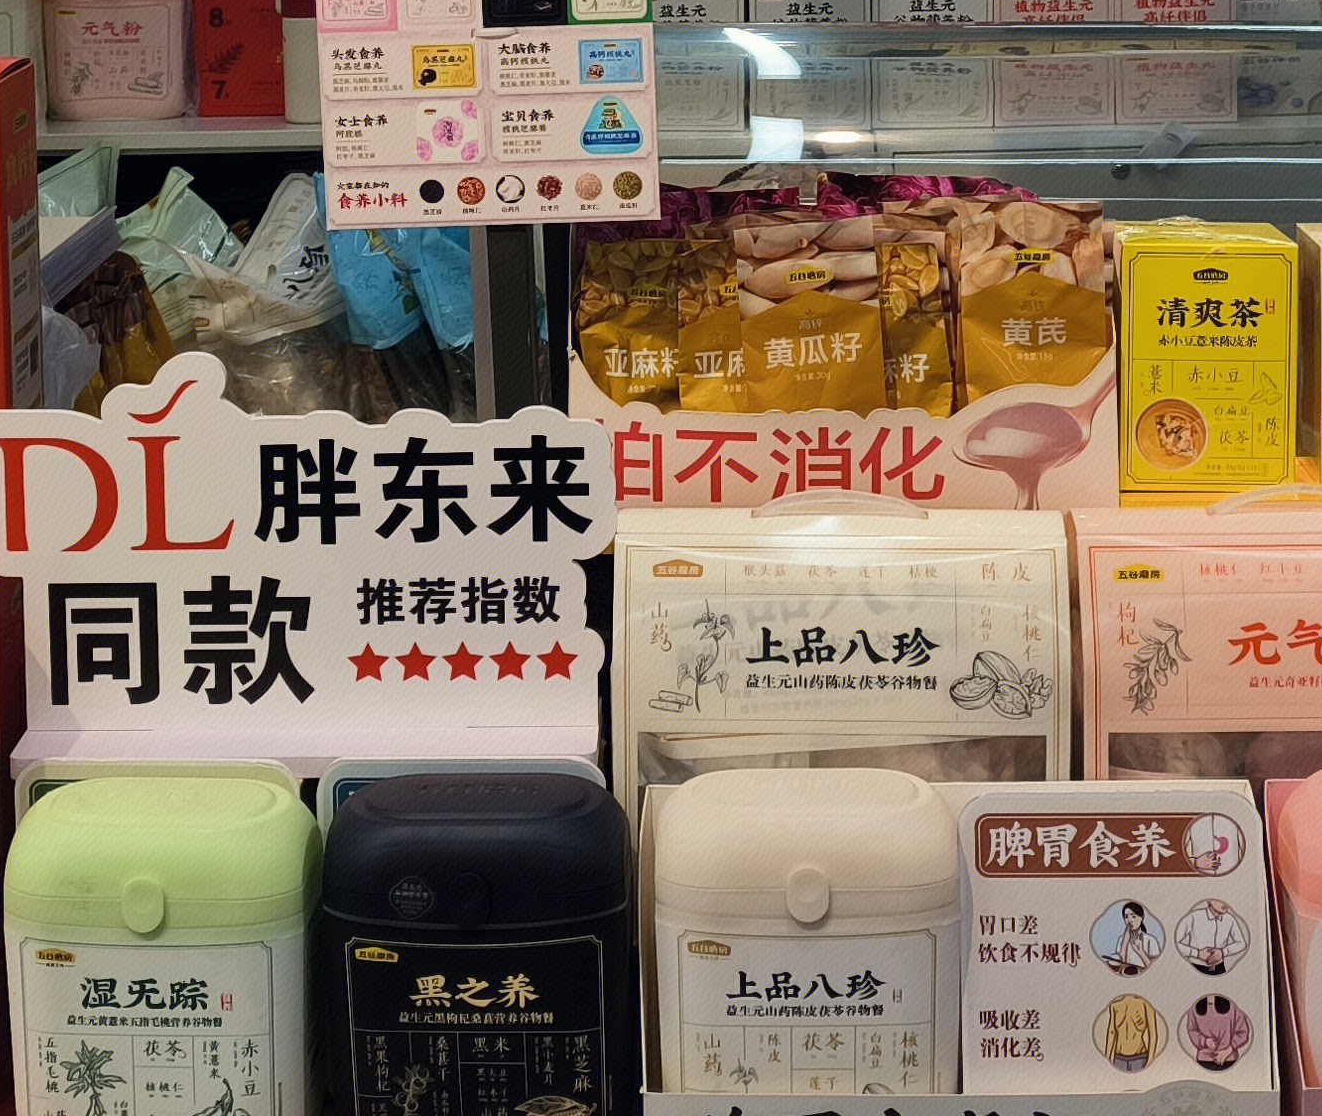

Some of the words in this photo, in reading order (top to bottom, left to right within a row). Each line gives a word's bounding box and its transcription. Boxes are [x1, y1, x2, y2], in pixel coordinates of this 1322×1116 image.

[81, 20, 143, 37] 元气粉
[498, 42, 551, 55] 大脑食养
[501, 109, 554, 122] 宝贝食养
[337, 192, 408, 209] 食养小料
[1155, 297, 1264, 328] 清爽茶
[1002, 318, 1067, 347] 黄芪
[763, 333, 863, 371] 黄瓜籽
[1188, 365, 1243, 384] 赤小豆
[1265, 417, 1279, 447] 陈皮
[254, 435, 593, 544] 胖东来
[981, 563, 1031, 582] 陈皮
[356, 577, 560, 624] 推荐指数
[649, 601, 671, 652] 山药
[1021, 604, 1042, 661] 核桃仁
[1117, 601, 1139, 646] 枸杞
[48, 575, 315, 705] 同款
[745, 626, 941, 667] 上品八珍
[986, 820, 1177, 869] 脾胃食养
[979, 914, 1038, 936] 胃口差
[409, 973, 539, 1008] 黑之养
[726, 970, 887, 1002] 上品八珍
[979, 1010, 1041, 1032] 吸收差
[144, 1040, 186, 1059] 茯苓
[472, 1037, 511, 1052] 黑米
[804, 1032, 845, 1051] 茯苓
[44, 1037, 60, 1094] 五指毛桃
[241, 1039, 261, 1097] 赤小豆
[573, 1035, 592, 1093] 黑芝麻
